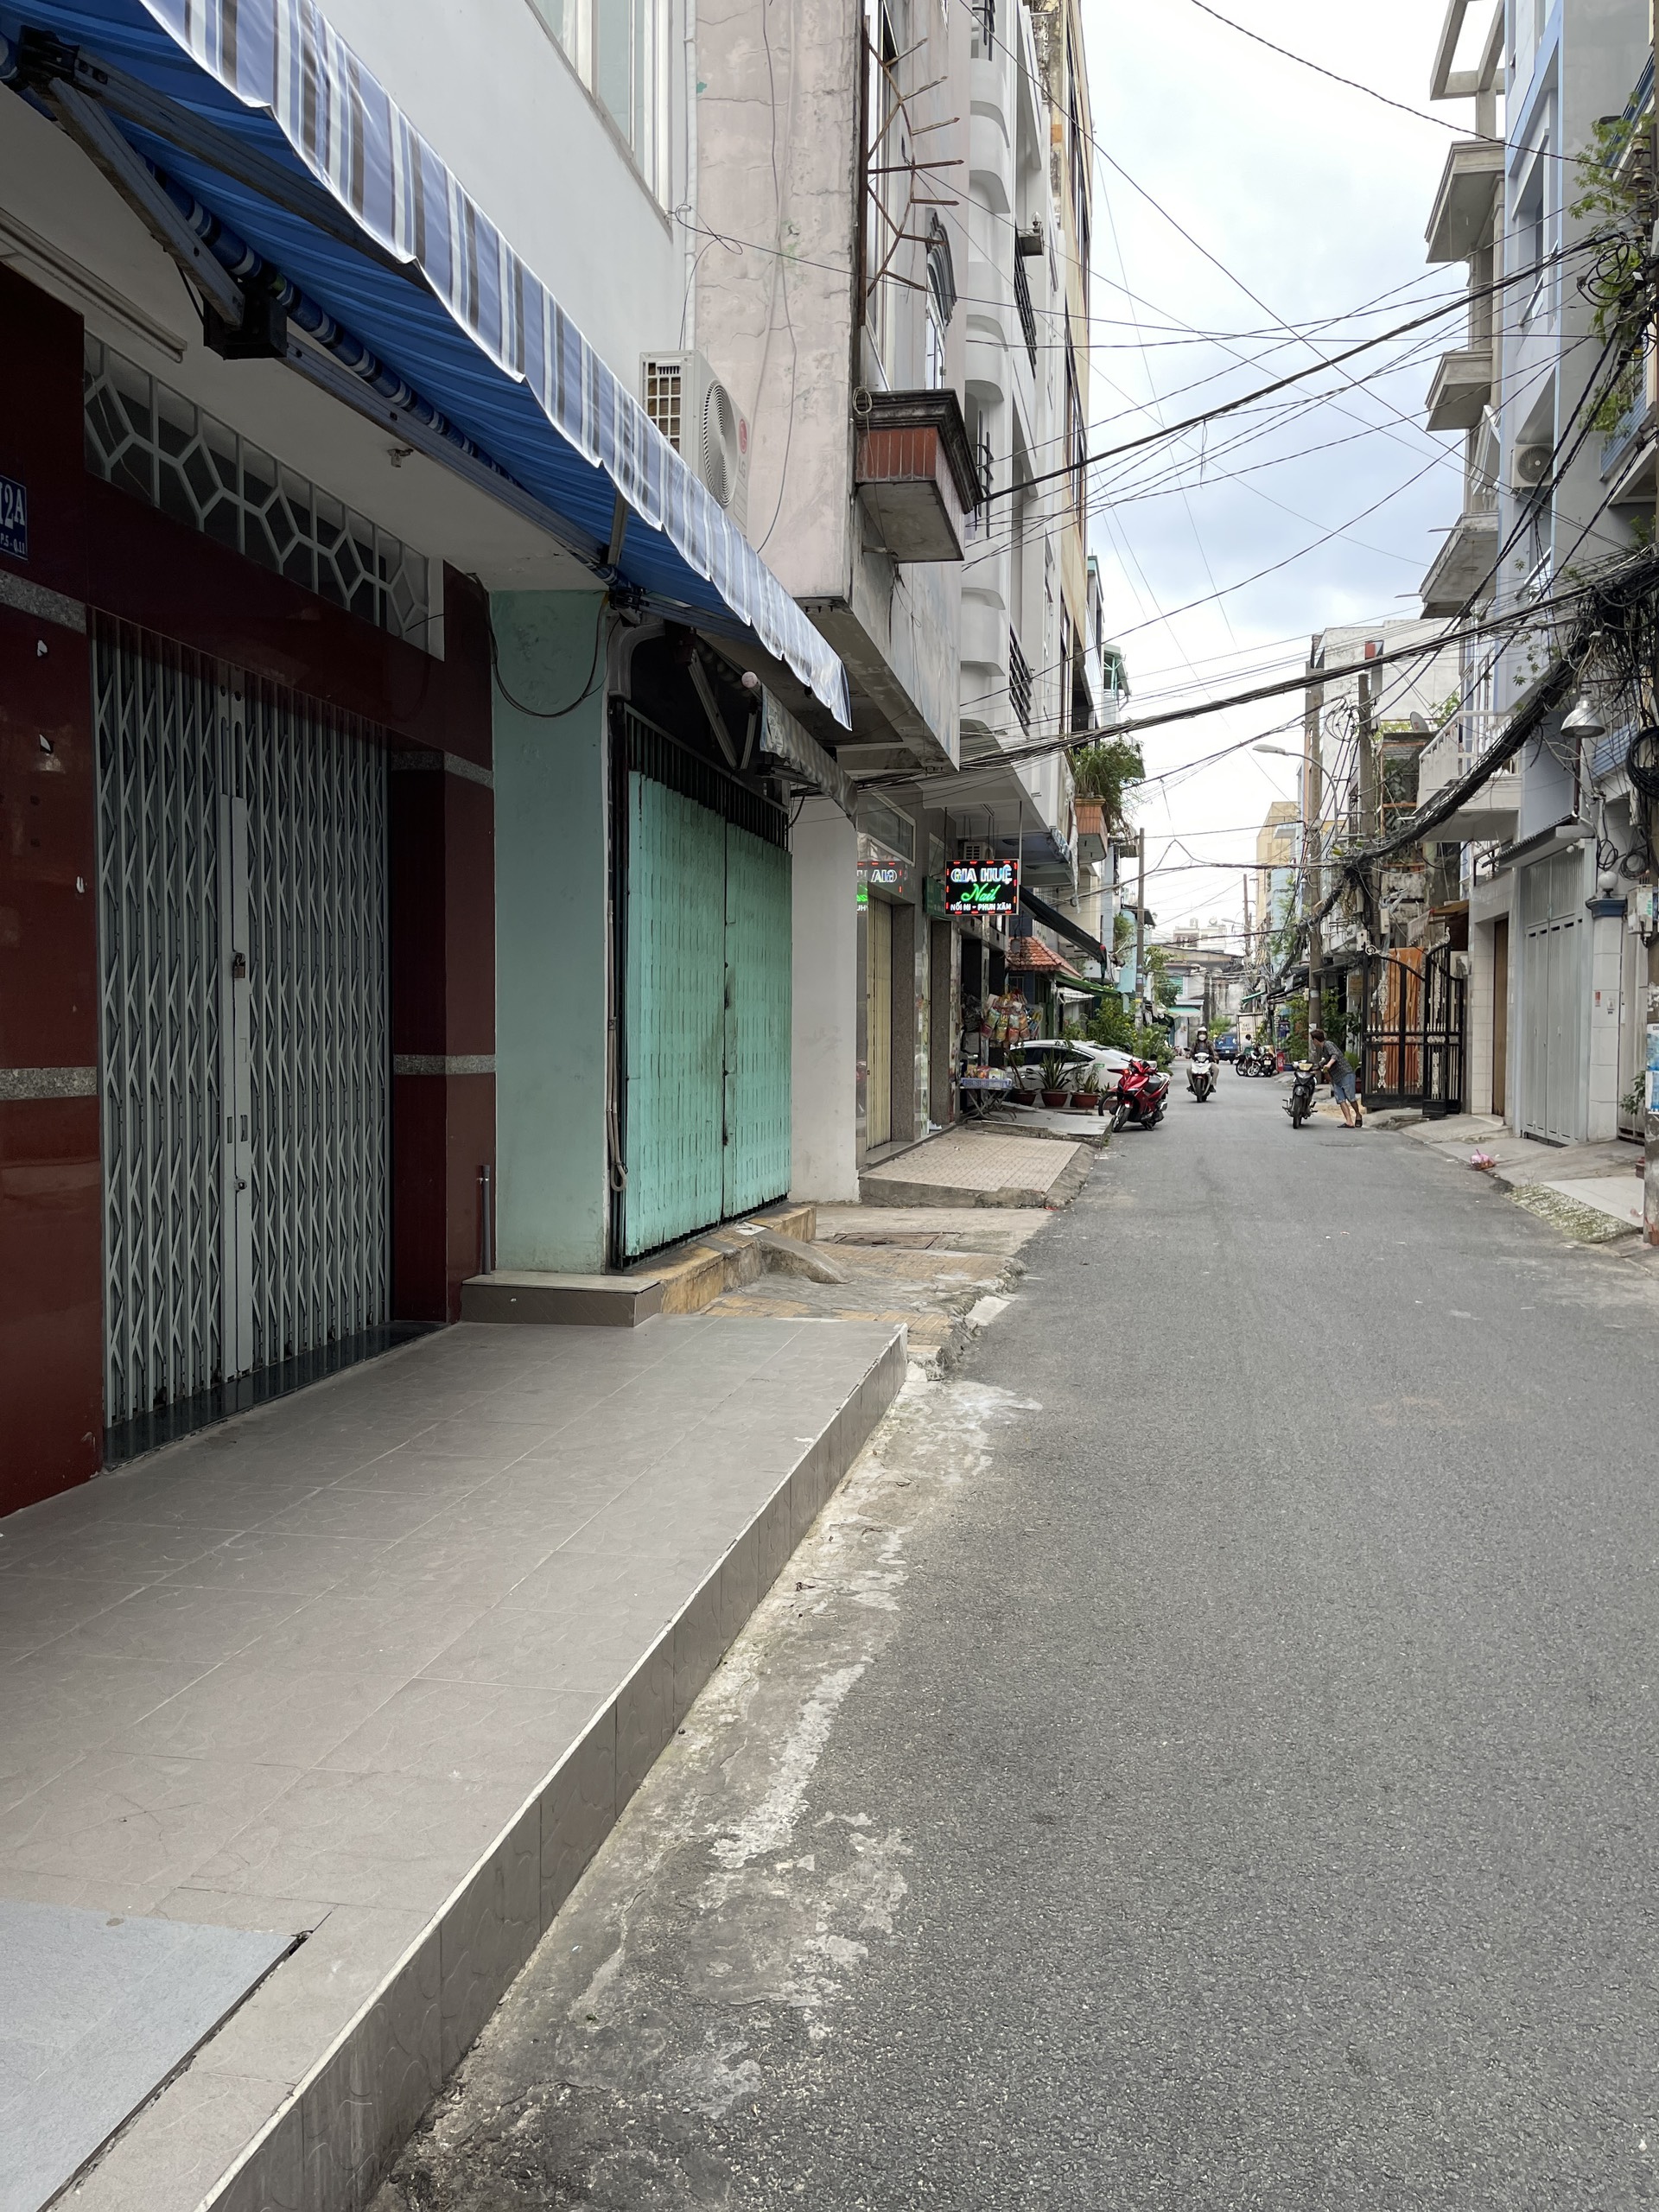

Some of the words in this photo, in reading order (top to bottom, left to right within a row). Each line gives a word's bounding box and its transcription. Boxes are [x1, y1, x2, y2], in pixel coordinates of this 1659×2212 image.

[950, 868, 977, 883] GIA
[980, 864, 1013, 885] HUỆ
[961, 883, 1001, 902] Nail
[950, 900, 963, 911] NỐI
